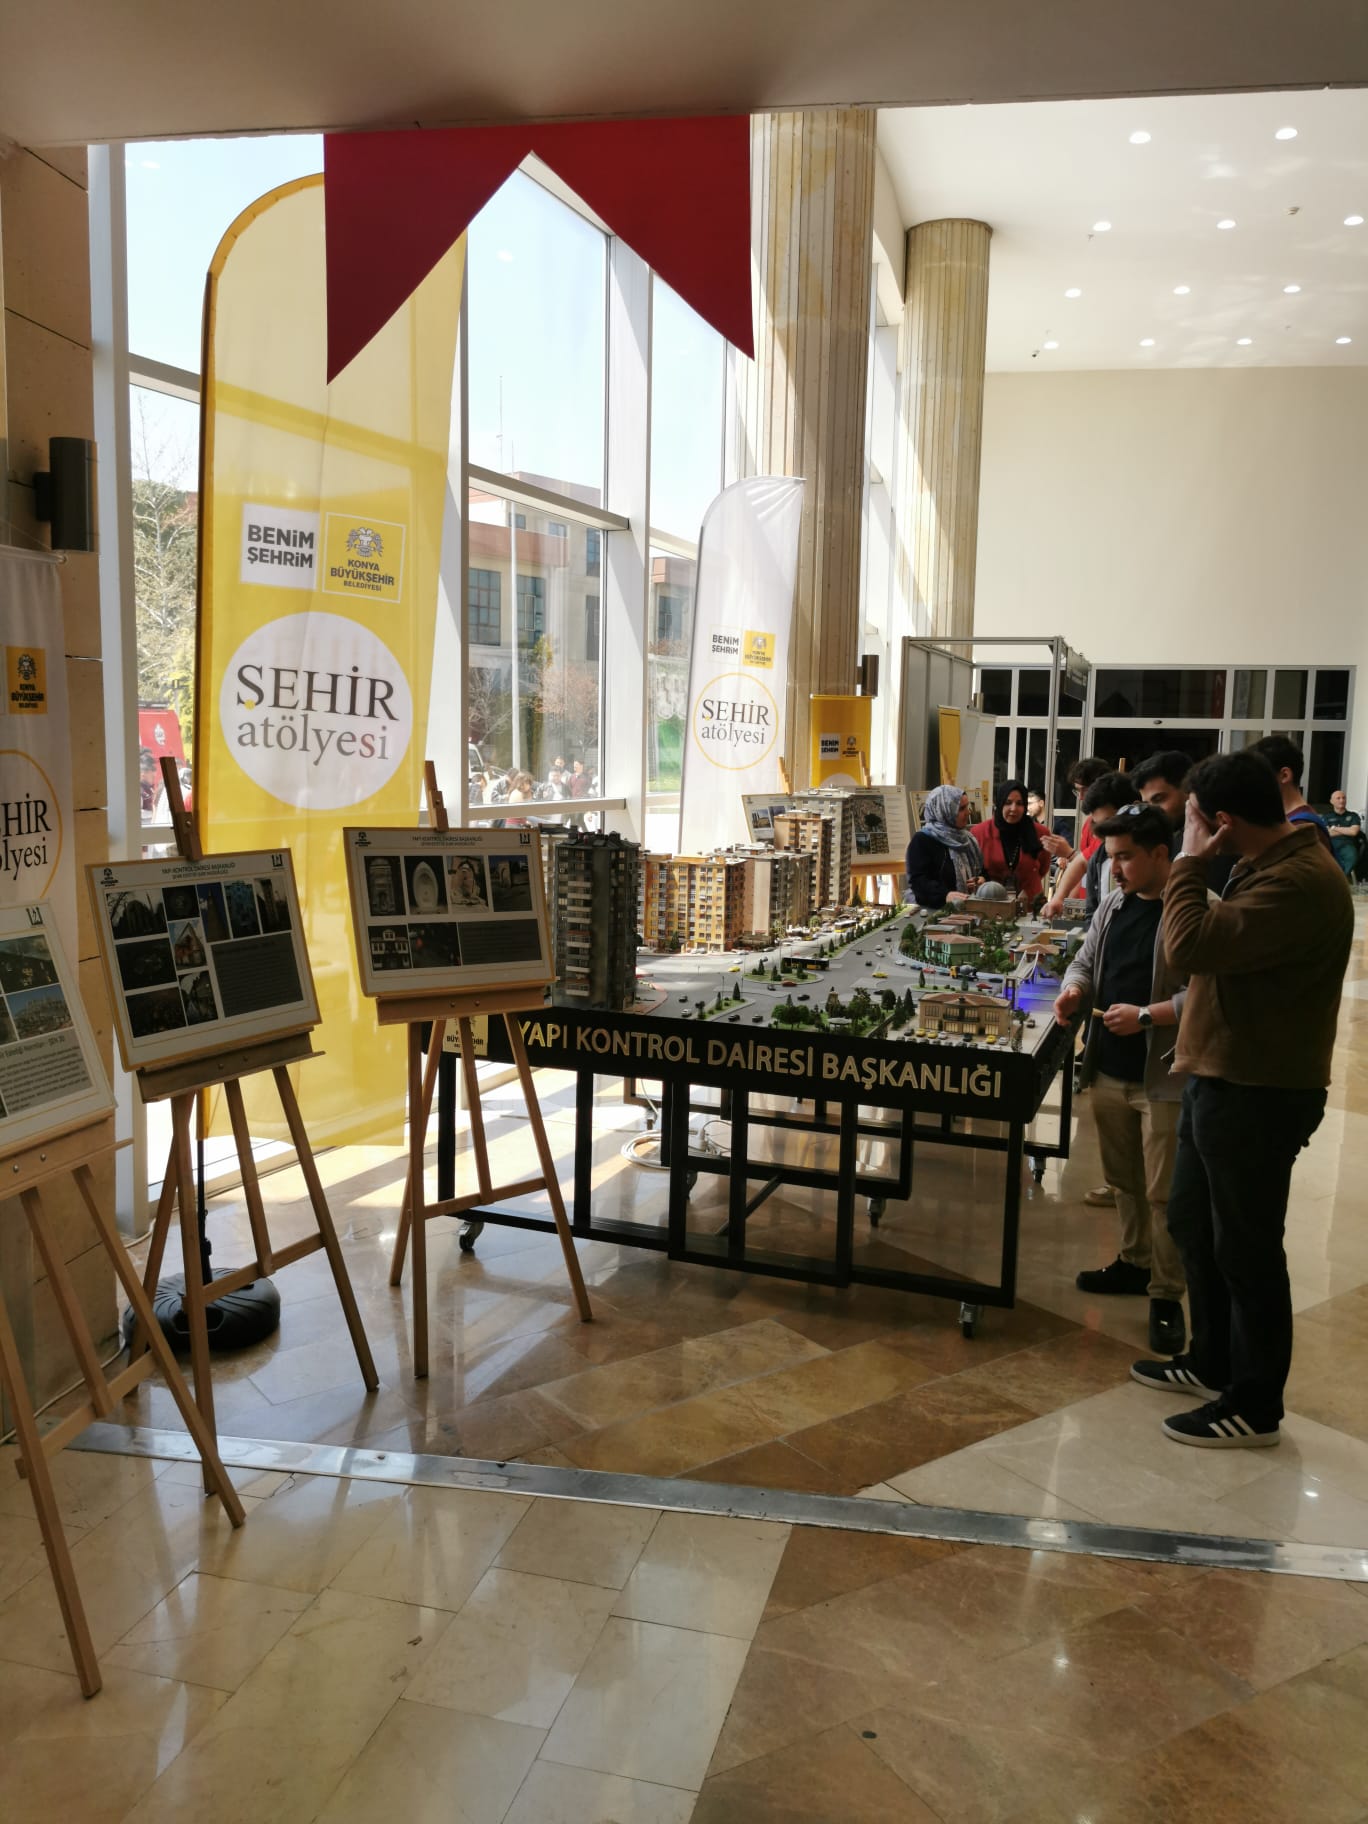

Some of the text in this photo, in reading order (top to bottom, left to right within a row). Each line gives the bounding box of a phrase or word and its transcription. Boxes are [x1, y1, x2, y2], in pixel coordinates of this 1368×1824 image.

[348, 559, 380, 571] KONYA
[237, 713, 389, 766] atölyesi
[701, 723, 765, 748] atölyesi
[0, 793, 52, 837] HİR
[517, 1020, 1001, 1098] YAPI KONTROL DAİRESİ BAŞKANLIĞI
